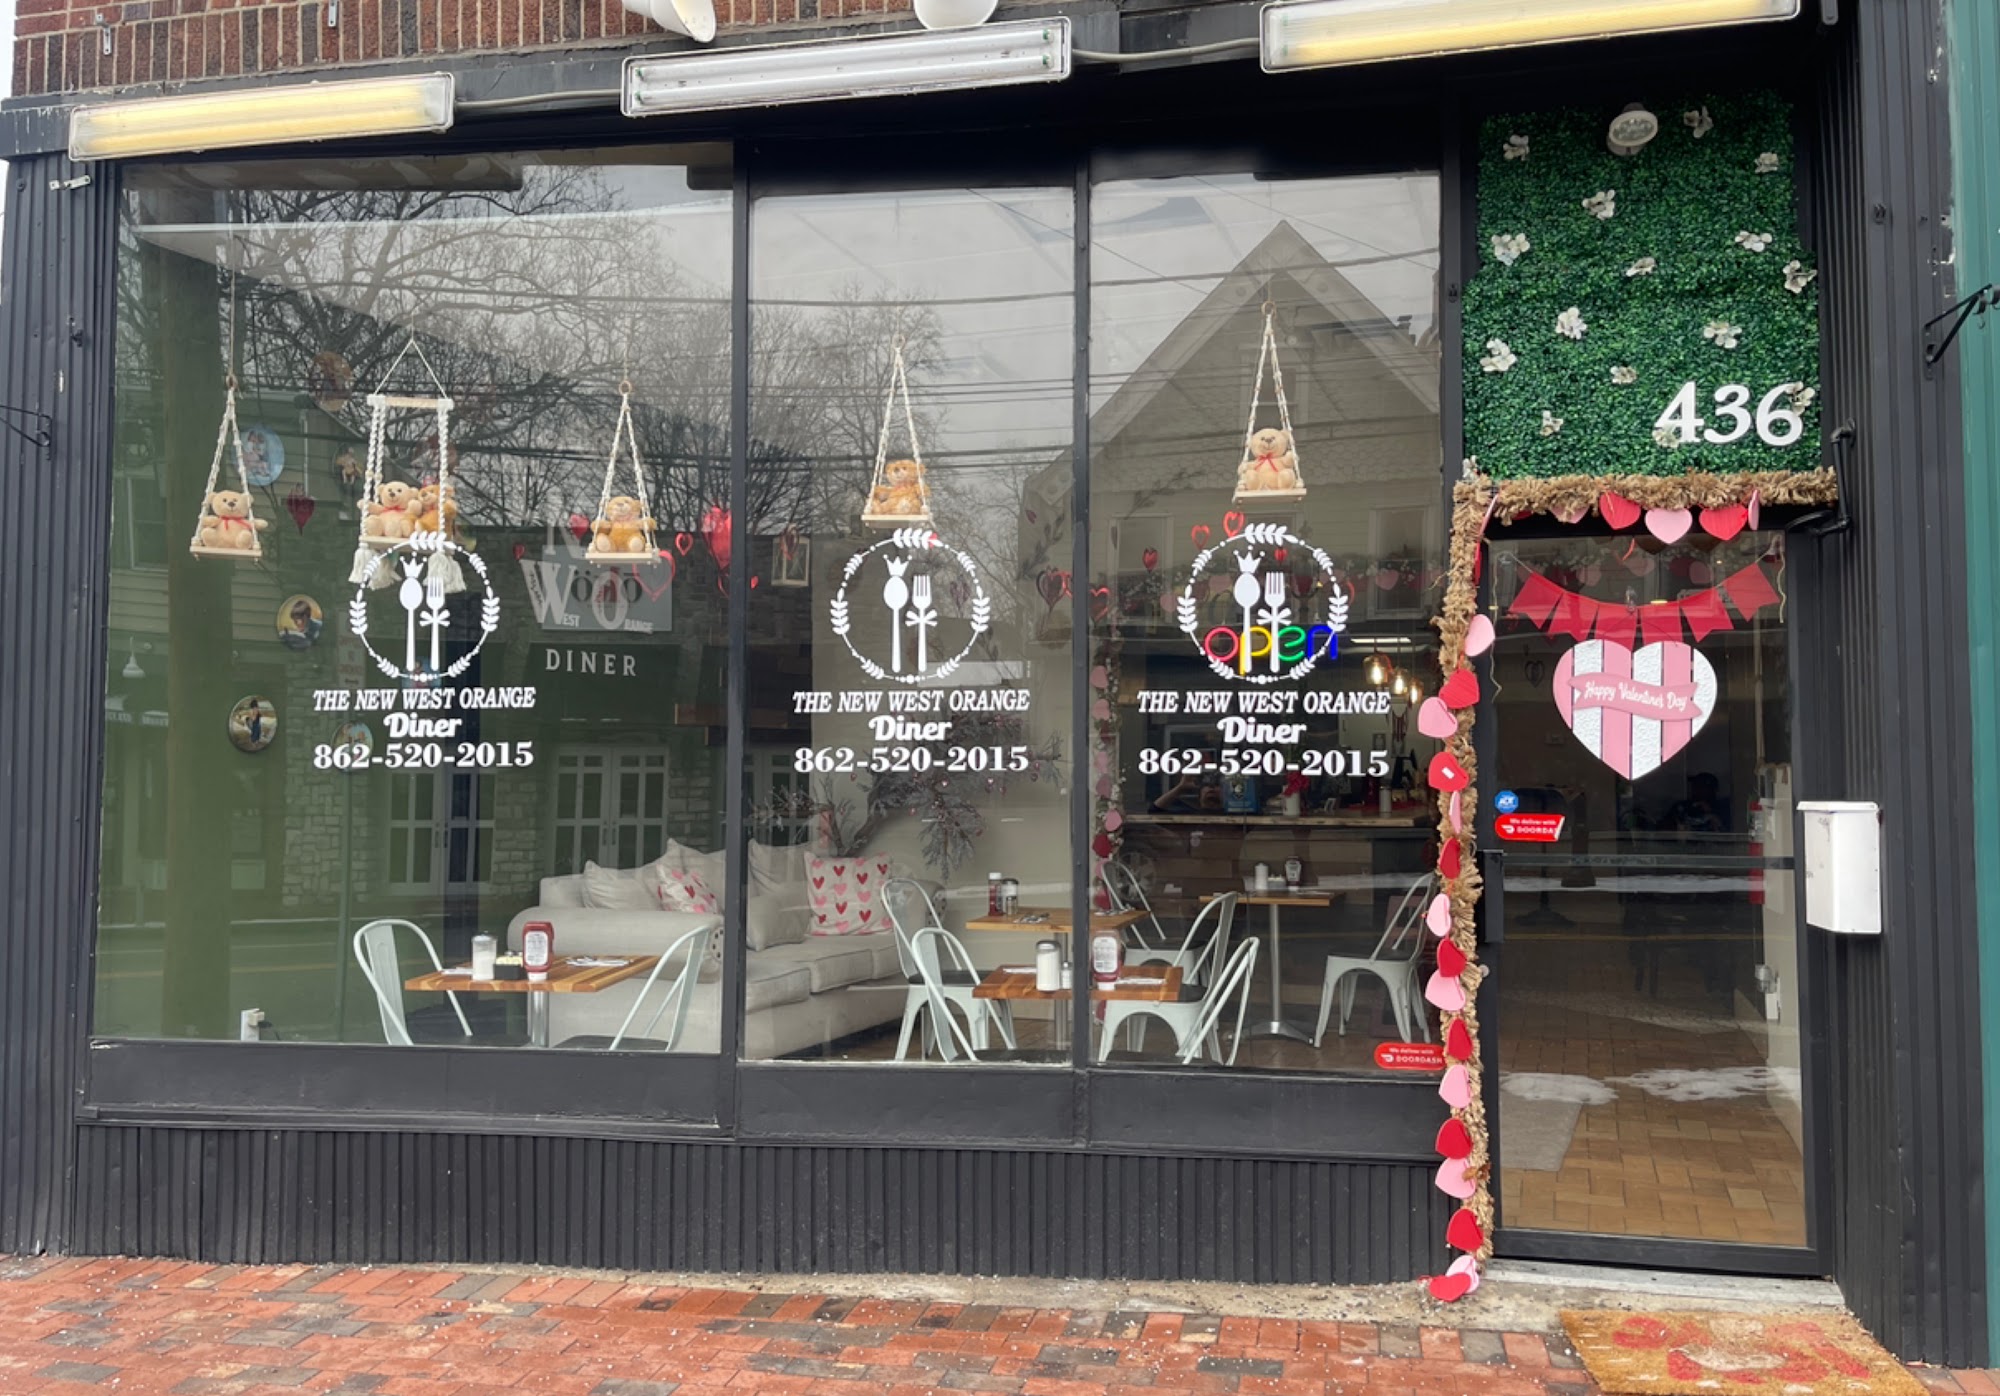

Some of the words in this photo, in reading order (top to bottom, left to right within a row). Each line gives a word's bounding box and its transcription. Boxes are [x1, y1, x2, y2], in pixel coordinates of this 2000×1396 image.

[1654, 381, 1804, 446] 436
[545, 649, 636, 676] DINER
[1203, 625, 1339, 677] open
[313, 690, 350, 711] THE
[354, 689, 398, 710] NEW
[402, 688, 456, 710] WEST
[459, 687, 536, 709] ORANGE
[792, 691, 833, 713] THE
[837, 691, 883, 712] NEW
[888, 690, 944, 712] WEST
[949, 689, 1031, 711] ORANGE
[1137, 691, 1179, 713] THE
[1183, 691, 1233, 713] NEW
[1238, 691, 1299, 713] WEST
[1303, 691, 1392, 714] ORANGE
[1584, 680, 1617, 701] Happy
[1667, 691, 1688, 712] Day
[383, 712, 463, 738] Diner
[868, 715, 952, 741] Diner
[1216, 716, 1307, 744] Diner
[313, 741, 535, 769] 862-520-2015
[794, 746, 1029, 773] 862-520-2015
[1138, 748, 1390, 776] 862-520-2015
[1395, 1055, 1442, 1064] DOORDASH
